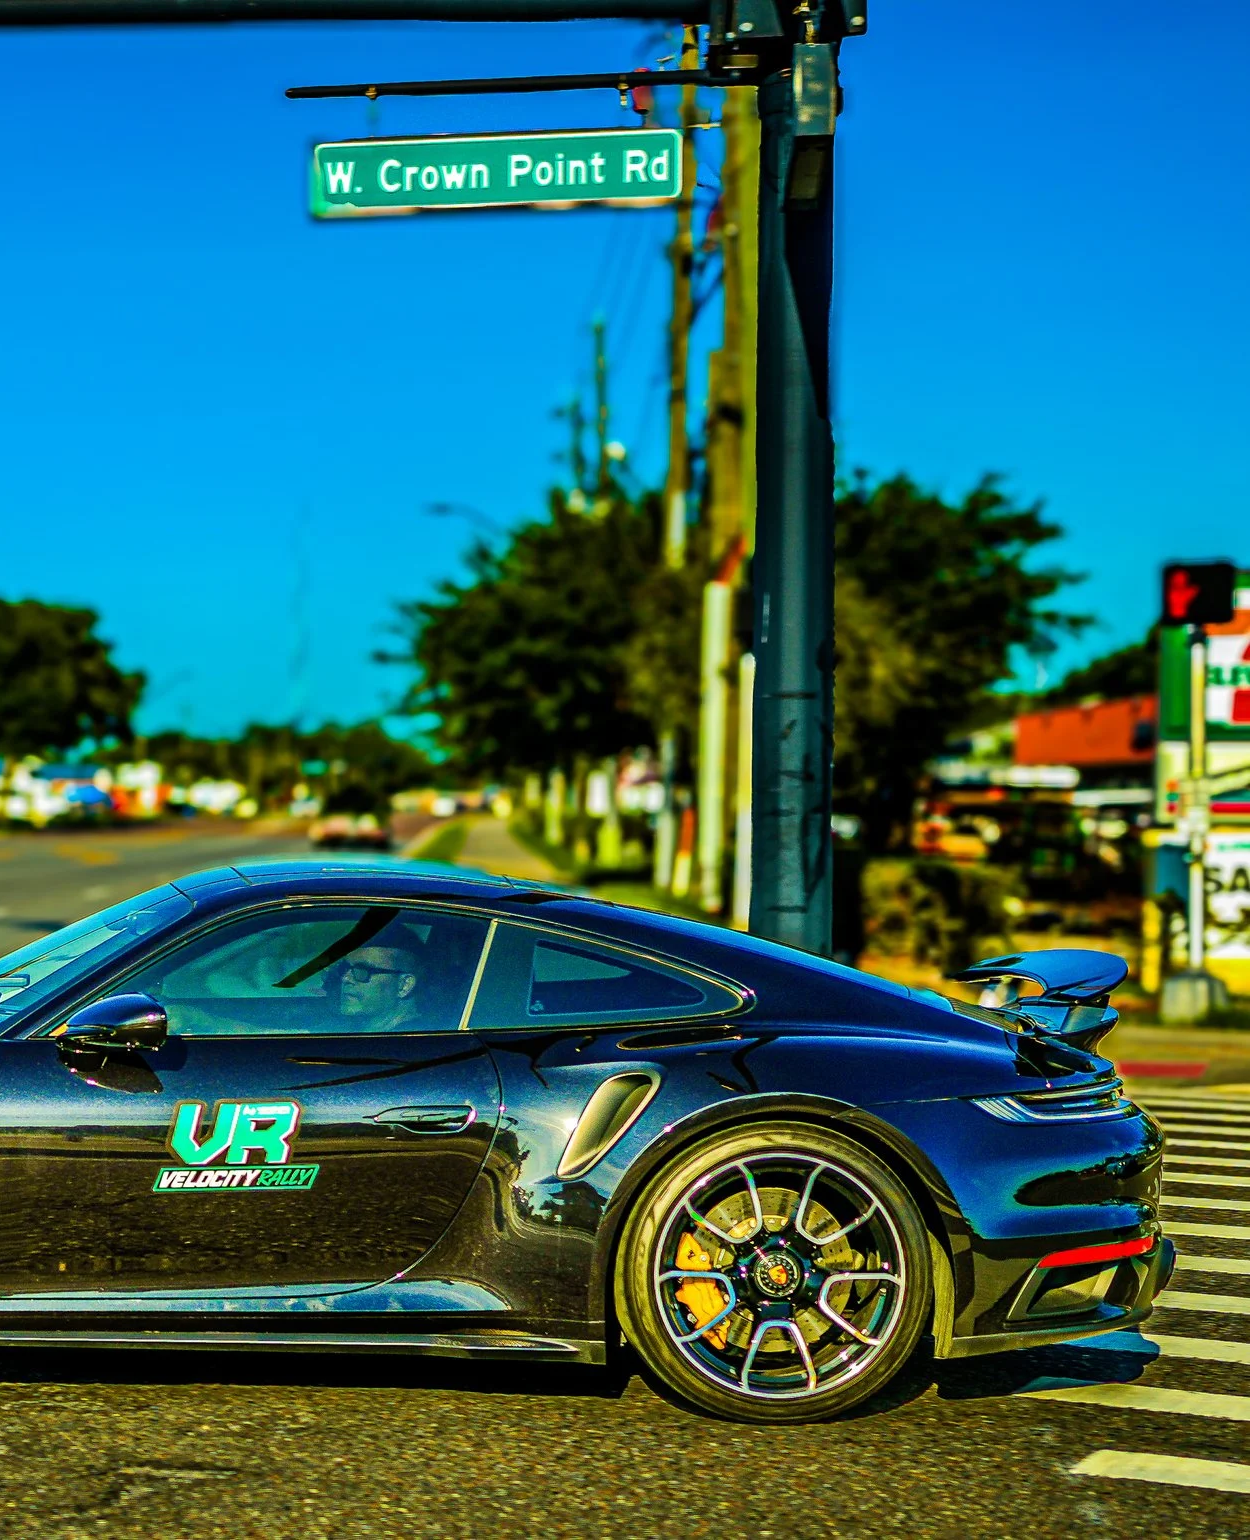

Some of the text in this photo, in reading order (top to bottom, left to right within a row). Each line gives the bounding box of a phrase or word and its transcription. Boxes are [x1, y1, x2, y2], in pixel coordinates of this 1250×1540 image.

[324, 149, 670, 195] W. Crown Point Rd
[171, 1101, 300, 1165] VR
[158, 1168, 313, 1188] VELOCITY RALLY
